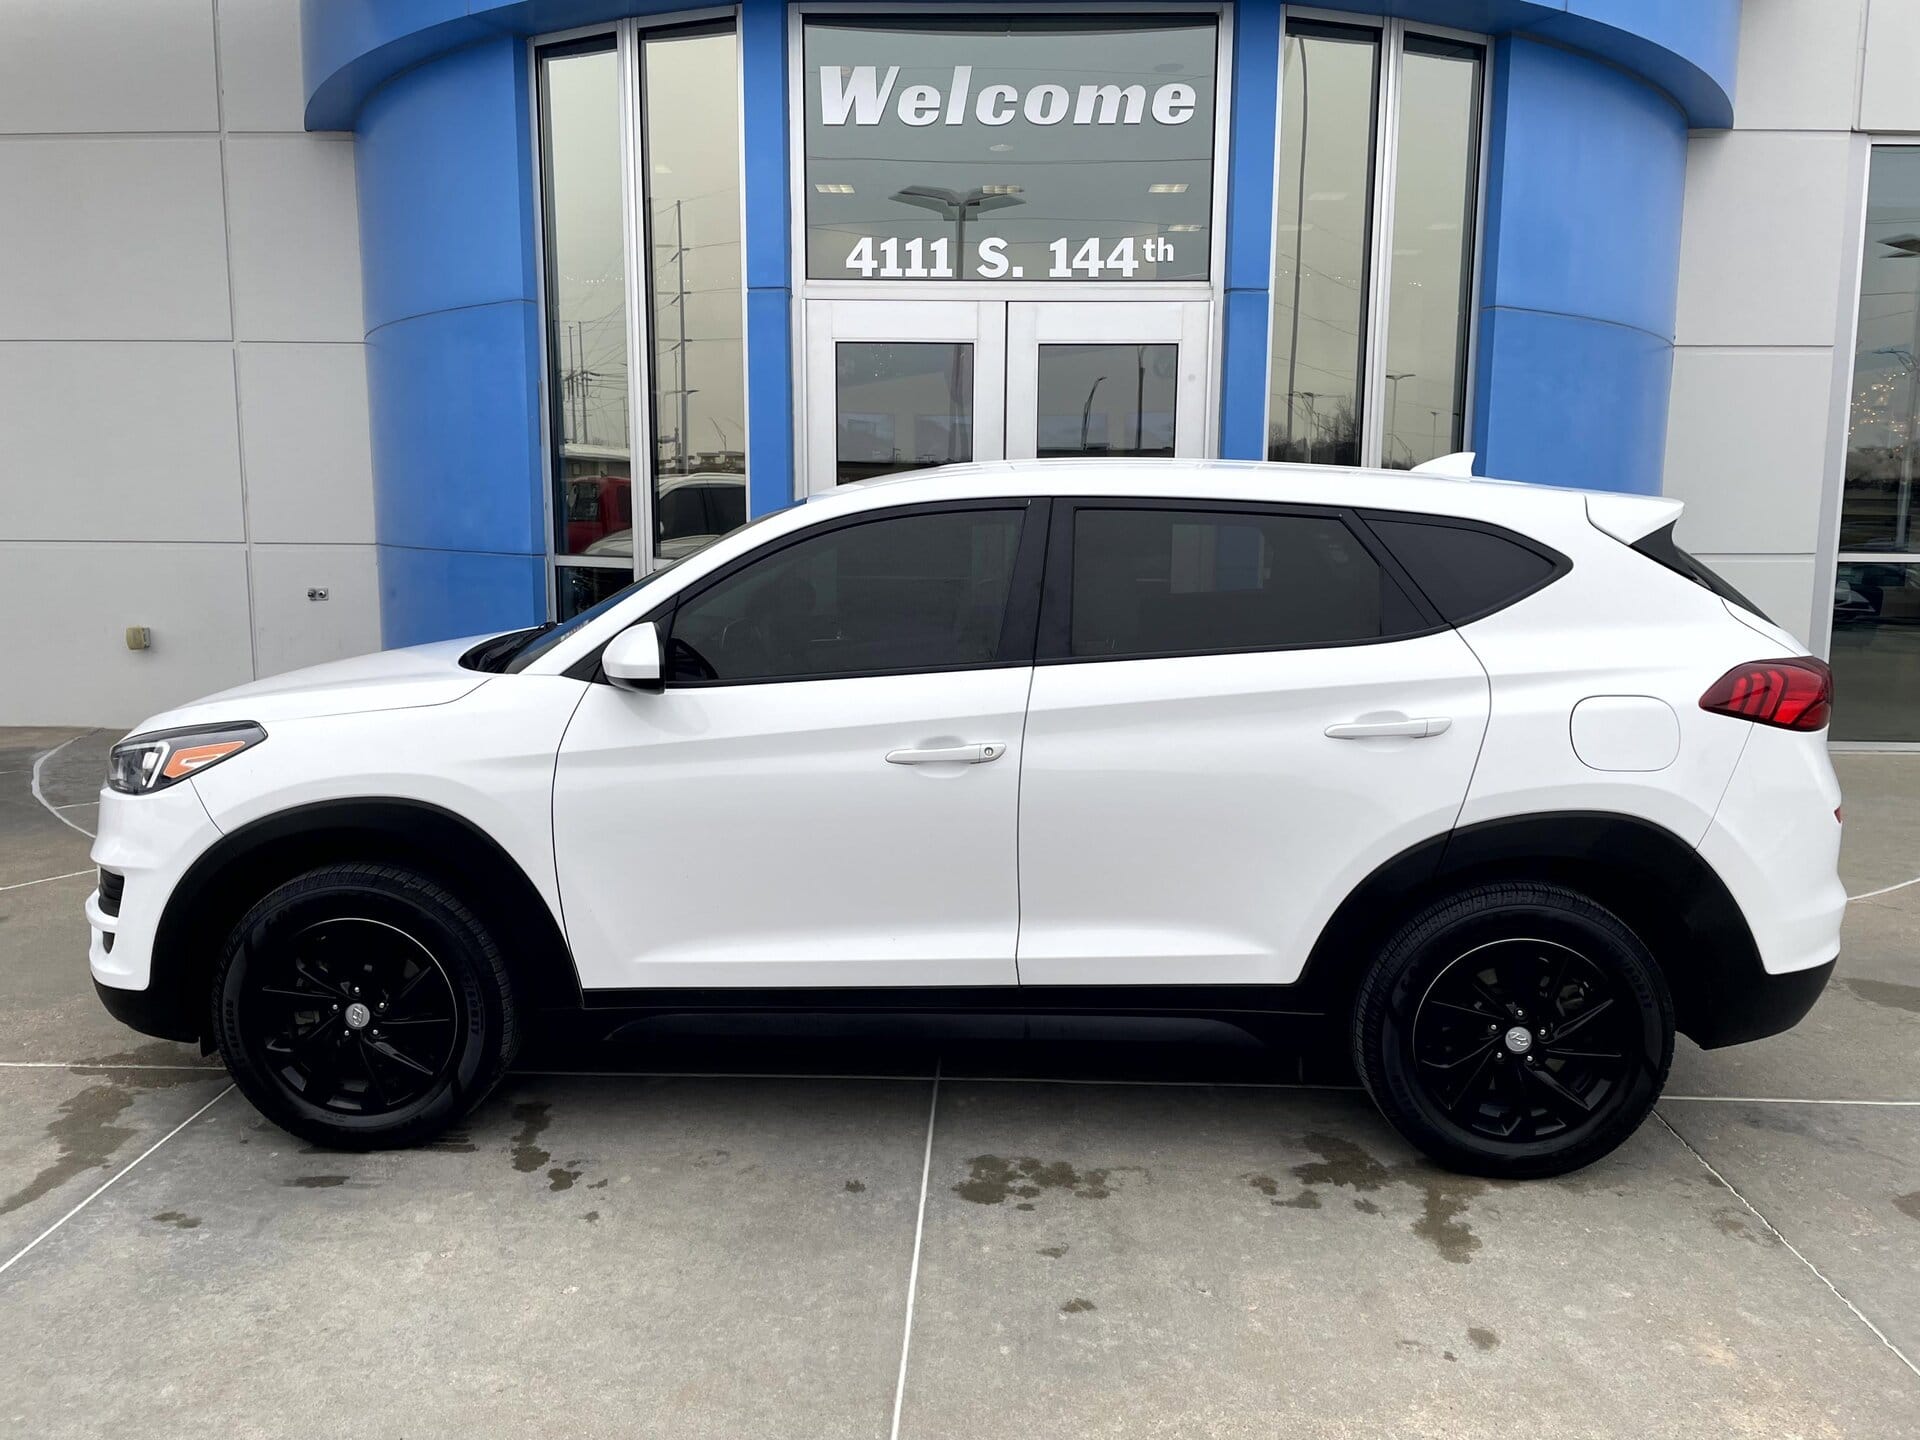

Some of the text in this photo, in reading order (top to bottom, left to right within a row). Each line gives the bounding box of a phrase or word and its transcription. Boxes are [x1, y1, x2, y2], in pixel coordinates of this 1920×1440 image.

[819, 65, 1197, 126] Welcome
[845, 236, 1174, 278] 4111 S. 144th
